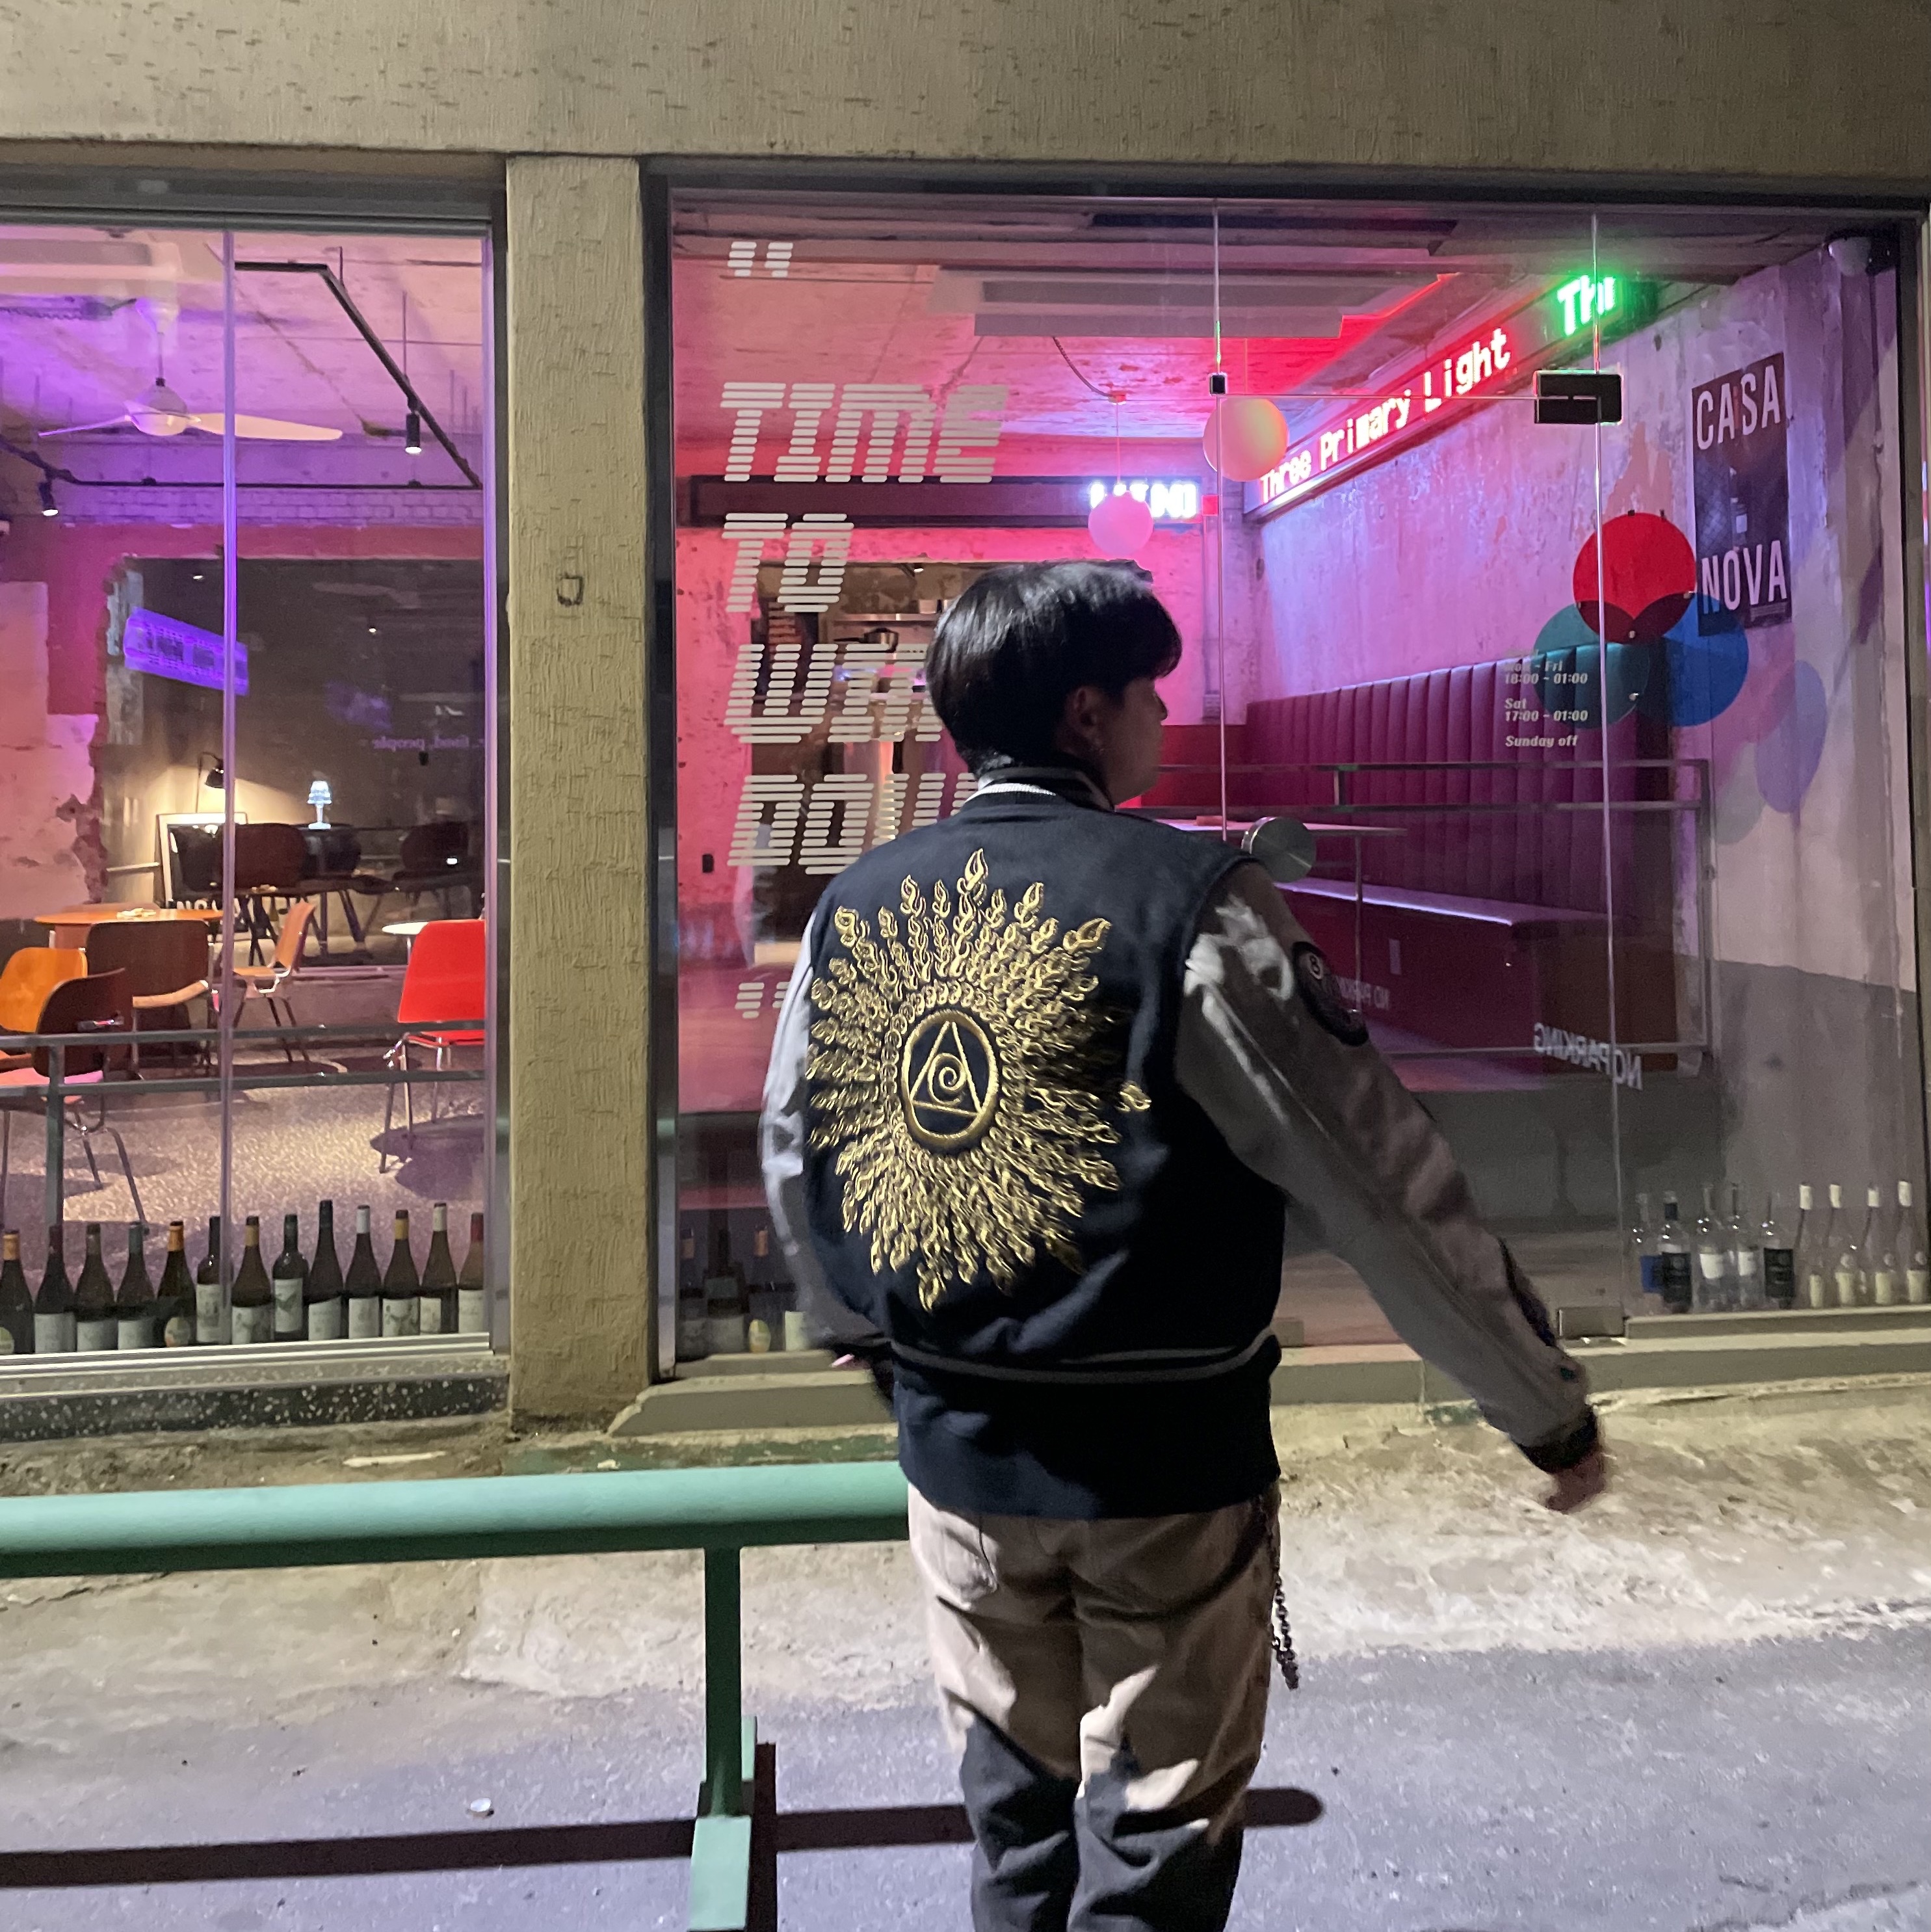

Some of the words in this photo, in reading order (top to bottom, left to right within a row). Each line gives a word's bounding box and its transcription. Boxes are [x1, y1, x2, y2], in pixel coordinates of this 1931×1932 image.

[720, 382, 1008, 483] TIME
[1260, 449, 1312, 503] Three
[1319, 389, 1412, 471] Primary
[1423, 327, 1511, 413] Light
[1696, 365, 1780, 450] CASA
[721, 512, 854, 613] TO
[1701, 540, 1787, 614] NOVA
[724, 643, 943, 743] WIN
[1504, 697, 1527, 709] Sat
[1505, 672, 1540, 685] 18:00
[1553, 672, 1588, 685] 01:00
[1505, 710, 1539, 722] 17:00
[1553, 710, 1588, 722] 01:00
[1504, 735, 1555, 748] Sunday
[1558, 734, 1579, 747] off
[727, 773, 978, 875] DOW
